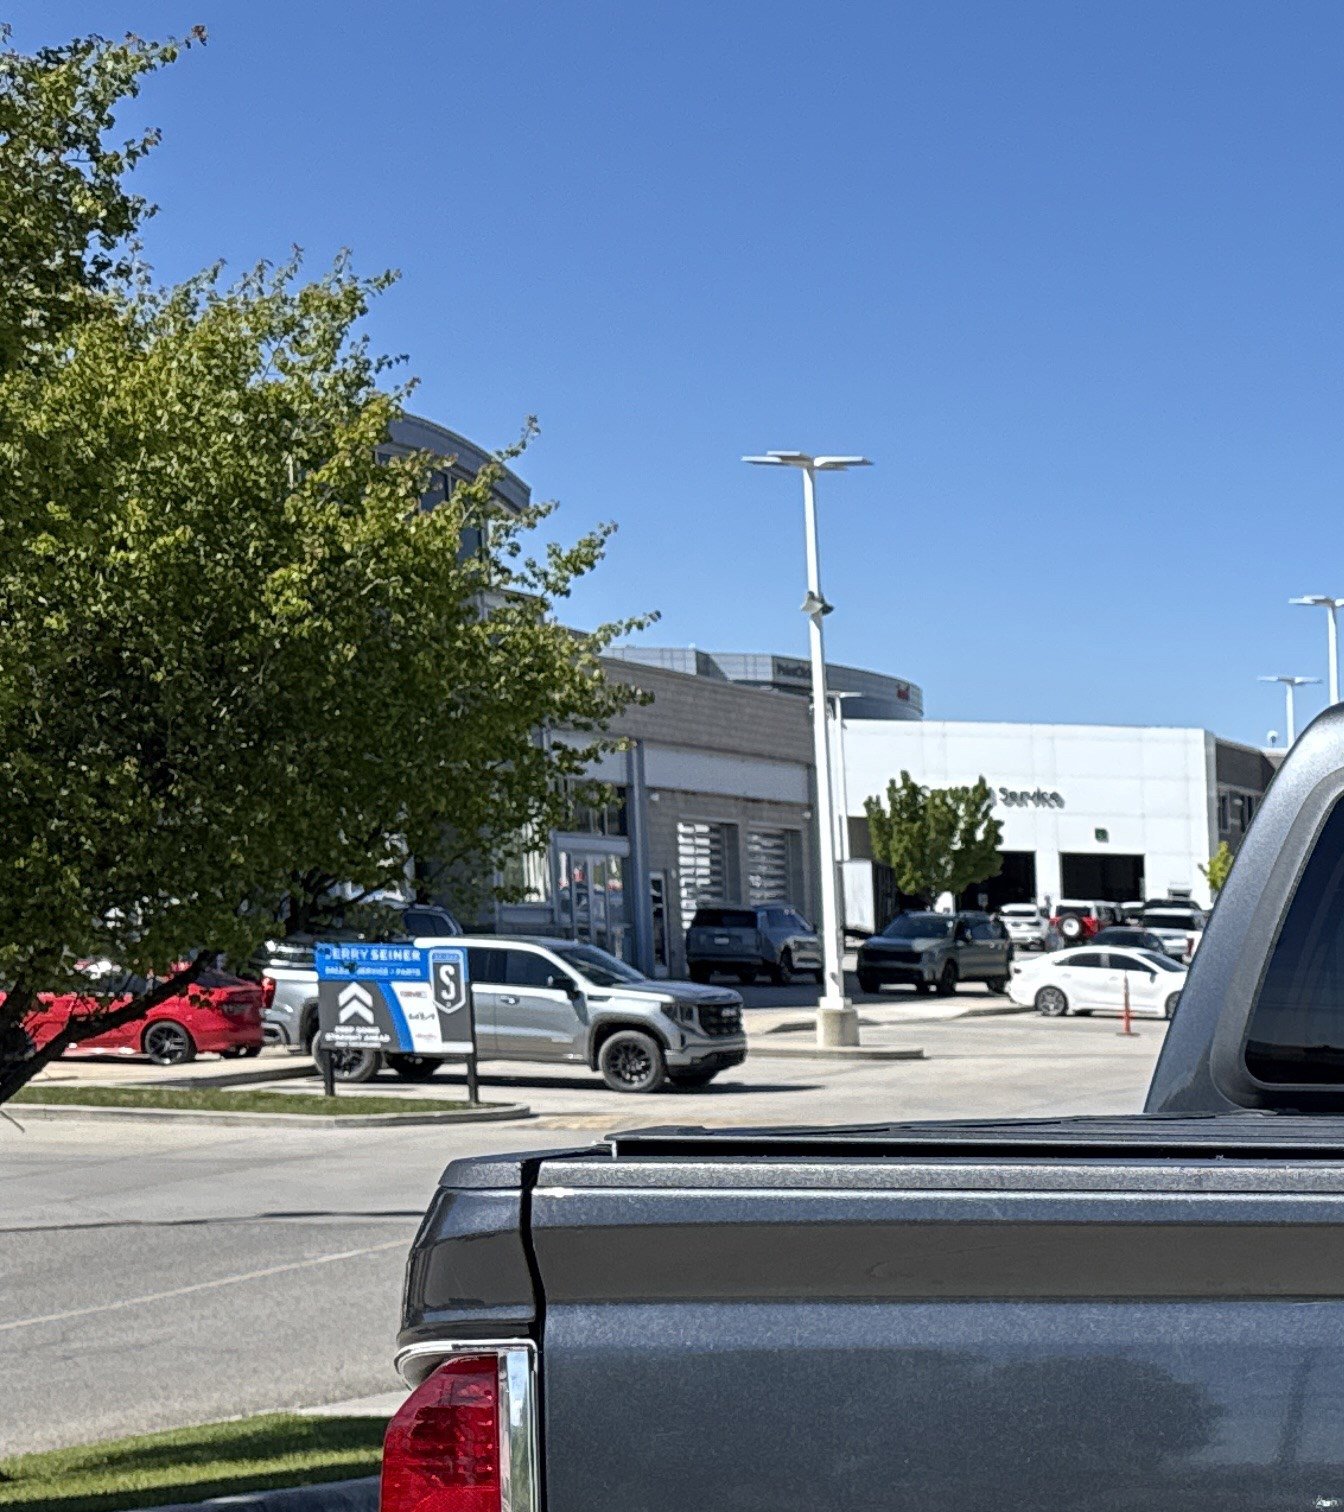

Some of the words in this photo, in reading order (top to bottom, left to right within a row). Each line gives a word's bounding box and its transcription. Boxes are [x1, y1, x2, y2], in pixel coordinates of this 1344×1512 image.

[999, 787, 1063, 805] Service
[370, 949, 421, 962] SEINER
[438, 964, 456, 1001] S
